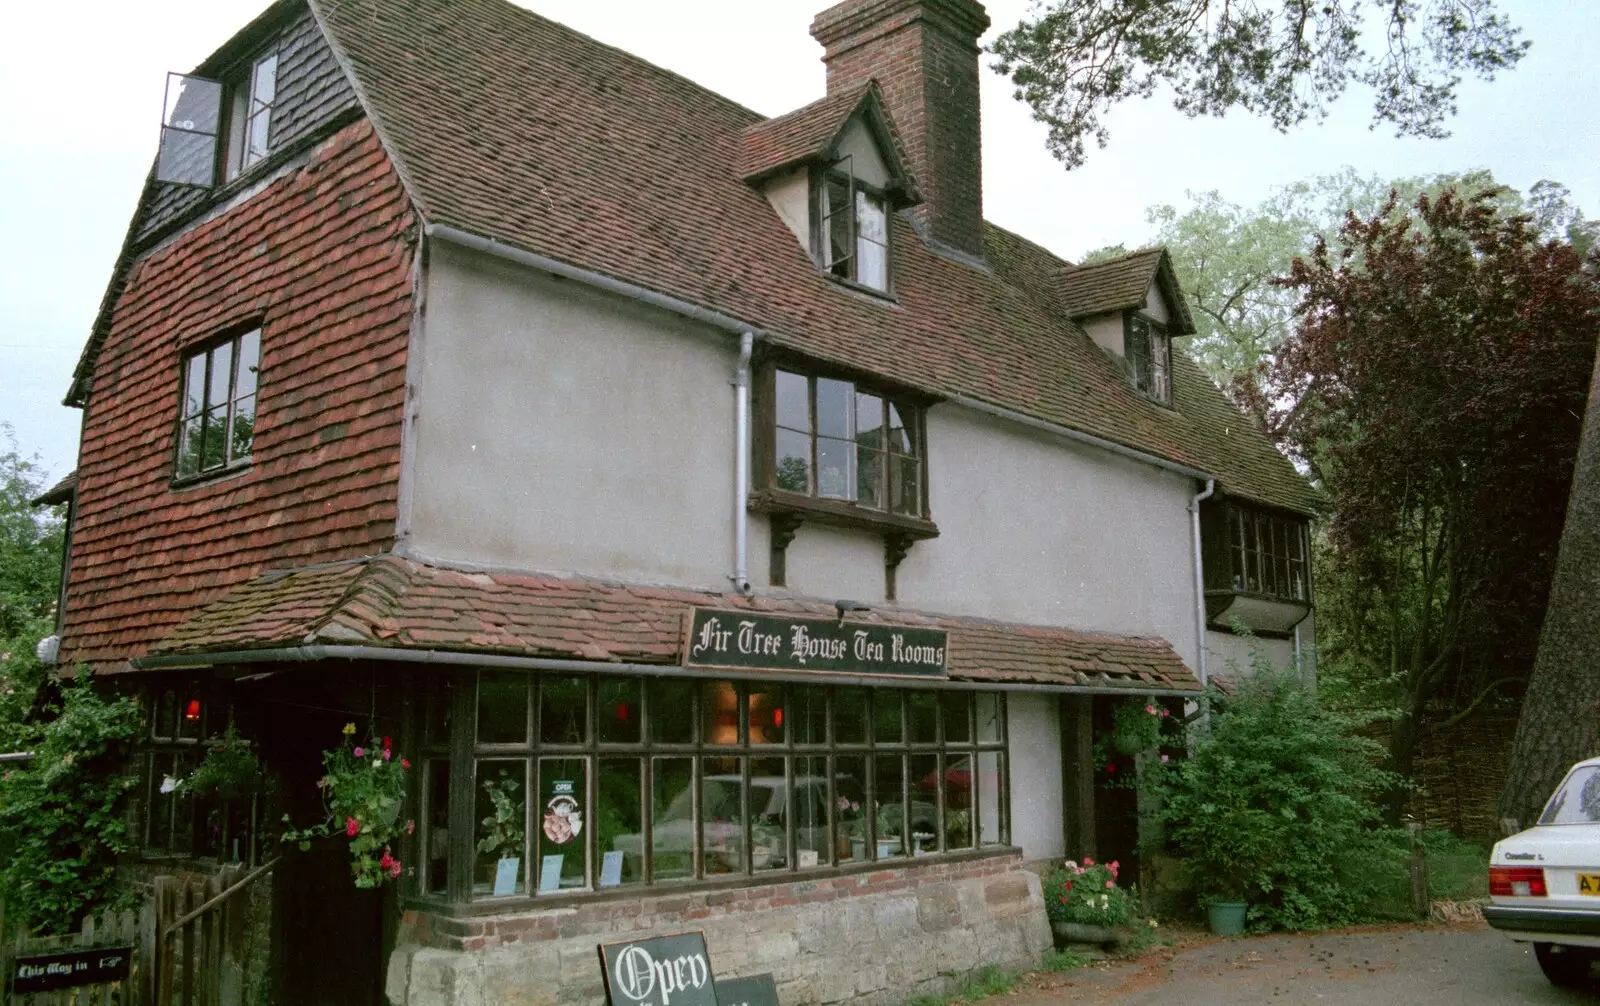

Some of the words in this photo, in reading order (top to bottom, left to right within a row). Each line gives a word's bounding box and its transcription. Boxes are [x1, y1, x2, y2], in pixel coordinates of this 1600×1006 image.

[693, 617, 733, 658] Fir
[738, 620, 782, 656] Tree
[790, 624, 847, 665] House
[854, 629, 884, 662] Tea
[891, 634, 944, 666] Rooms
[18, 964, 45, 979] This
[47, 962, 73, 975] Way
[75, 960, 88, 971] in
[615, 944, 708, 1005] Open
